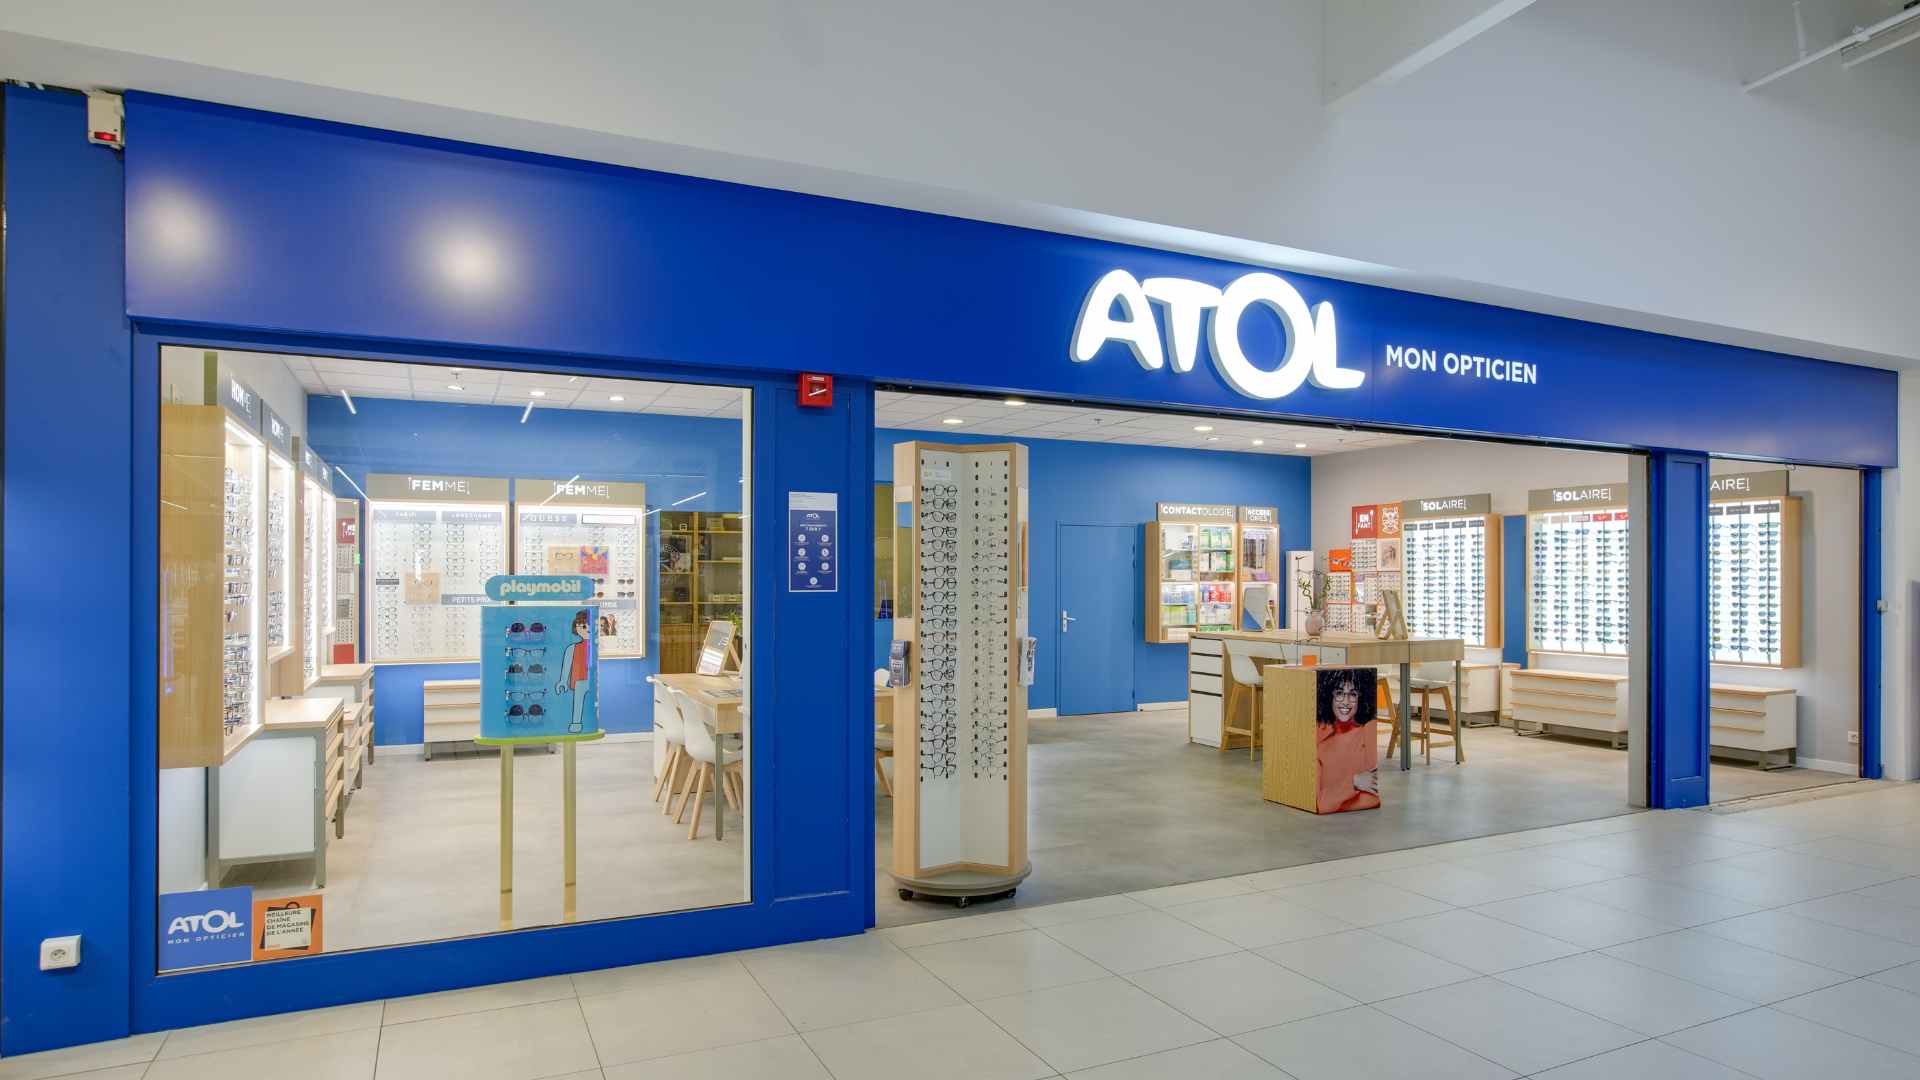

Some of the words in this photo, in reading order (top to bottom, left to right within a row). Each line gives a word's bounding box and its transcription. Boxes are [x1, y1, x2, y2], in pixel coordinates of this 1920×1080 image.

[1069, 269, 1366, 399] ATOL
[1386, 344, 1437, 372] MON
[1443, 352, 1537, 385] OPTICIEN
[411, 479, 467, 492] FEMME
[556, 484, 606, 496] FEMME
[1709, 477, 1746, 491] AIRE
[1555, 488, 1609, 502] SOLAIRE
[1422, 499, 1464, 511] SOLAIRE
[1162, 506, 1232, 517] CONTACTOLOGIE
[1247, 508, 1270, 516] ACCESS
[1359, 513, 1369, 522] EN
[530, 514, 567, 522] GUESS
[500, 579, 581, 597] playmobil
[266, 909, 301, 918] MEILLEURE
[167, 909, 245, 935] ATOL
[276, 920, 310, 929] MAGASINS
[276, 927, 304, 935] L'ANNÉE
[167, 937, 190, 945] MON
[195, 931, 245, 942] OPTICIEN
